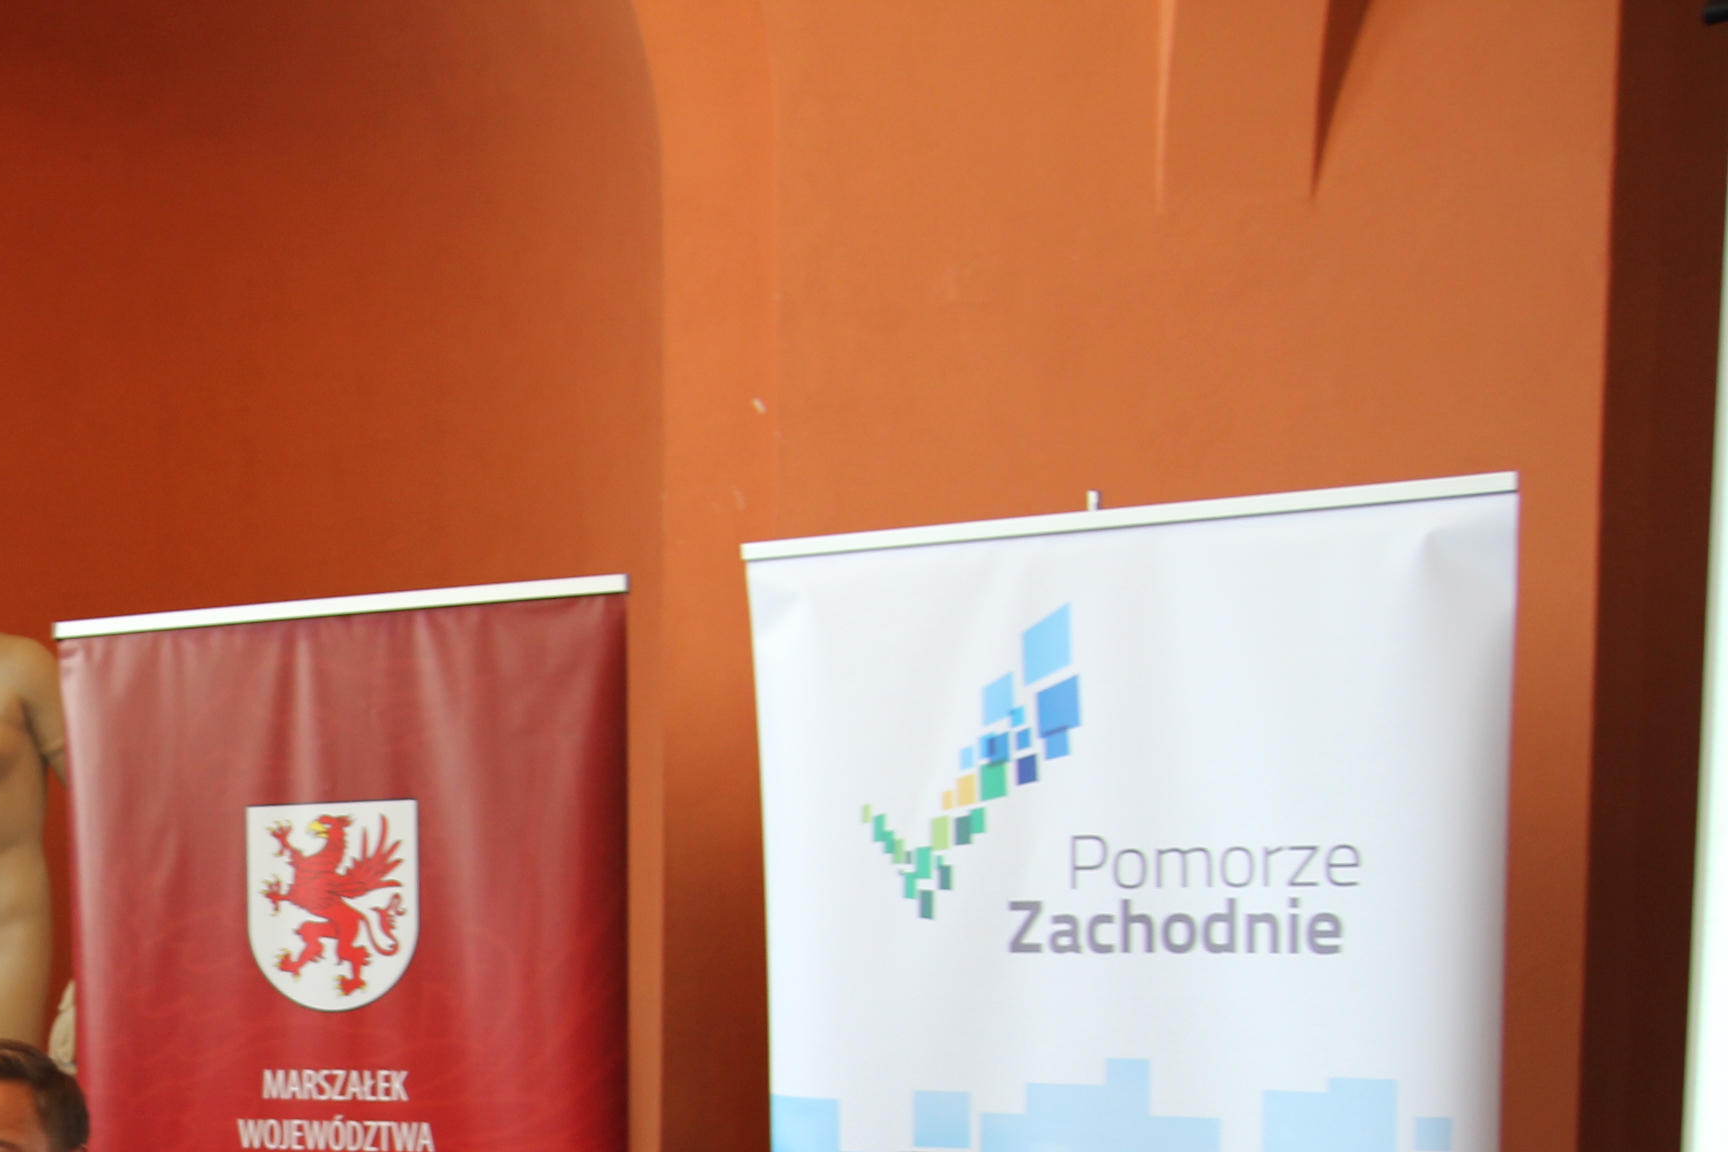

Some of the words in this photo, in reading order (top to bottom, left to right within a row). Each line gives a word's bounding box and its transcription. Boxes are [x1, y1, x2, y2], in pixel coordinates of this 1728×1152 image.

[1069, 833, 1362, 890] Pomorze
[1007, 896, 1344, 955] Zachodnie
[262, 1068, 410, 1102] MARSZAŁEK
